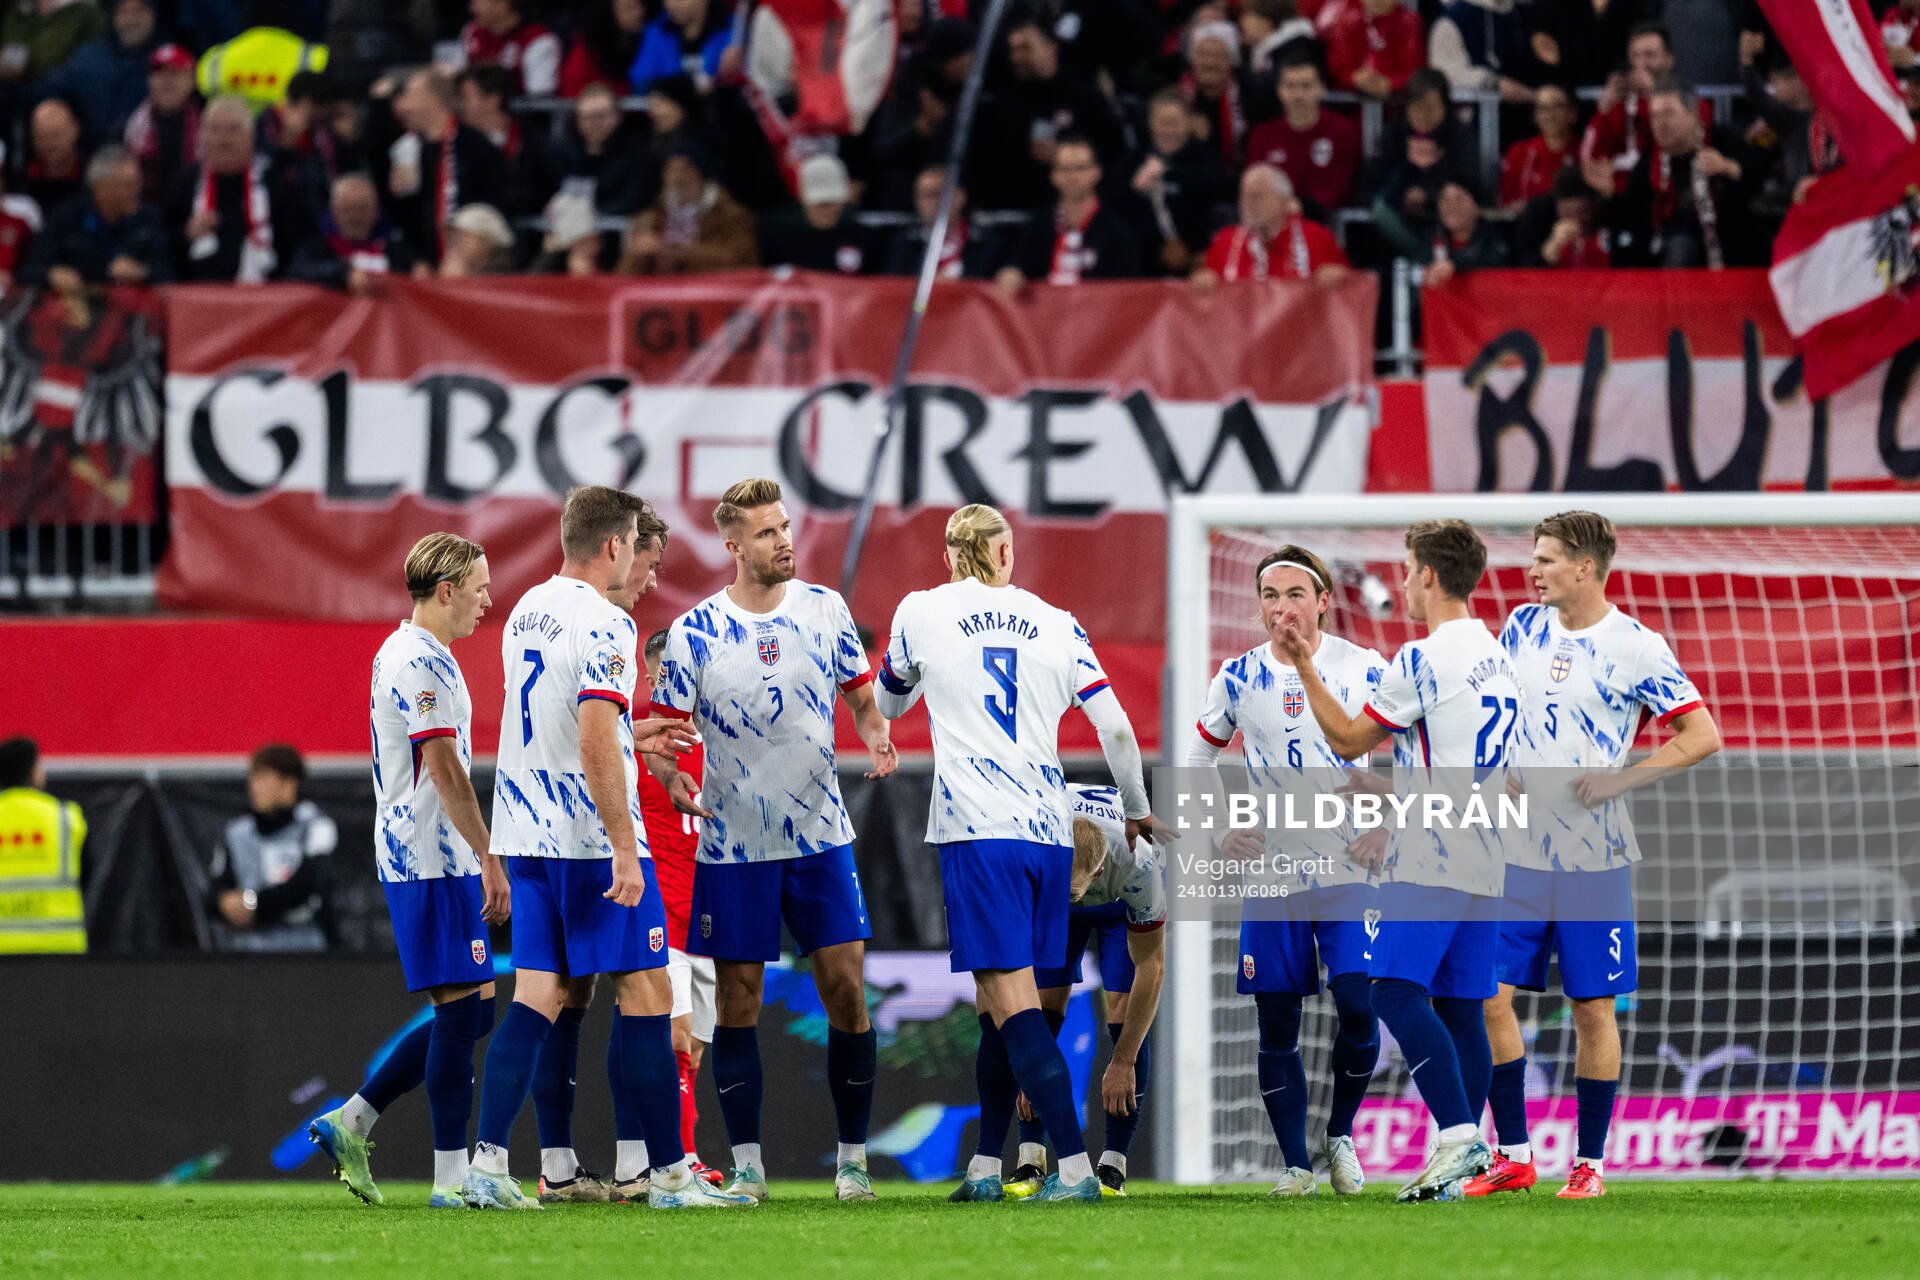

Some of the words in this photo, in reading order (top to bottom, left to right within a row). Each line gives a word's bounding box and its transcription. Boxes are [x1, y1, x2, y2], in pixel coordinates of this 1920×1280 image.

[188, 369, 648, 503] GLBG
[777, 380, 1352, 516] CREW
[957, 611, 1039, 641] HAALAND
[520, 648, 546, 748] 7
[767, 686, 784, 725] 3
[982, 646, 1019, 745] 9
[1544, 703, 1559, 741] 5
[1287, 738, 1304, 776] 6
[1609, 927, 1622, 965] 5
[1816, 1101, 1920, 1158] Ma
